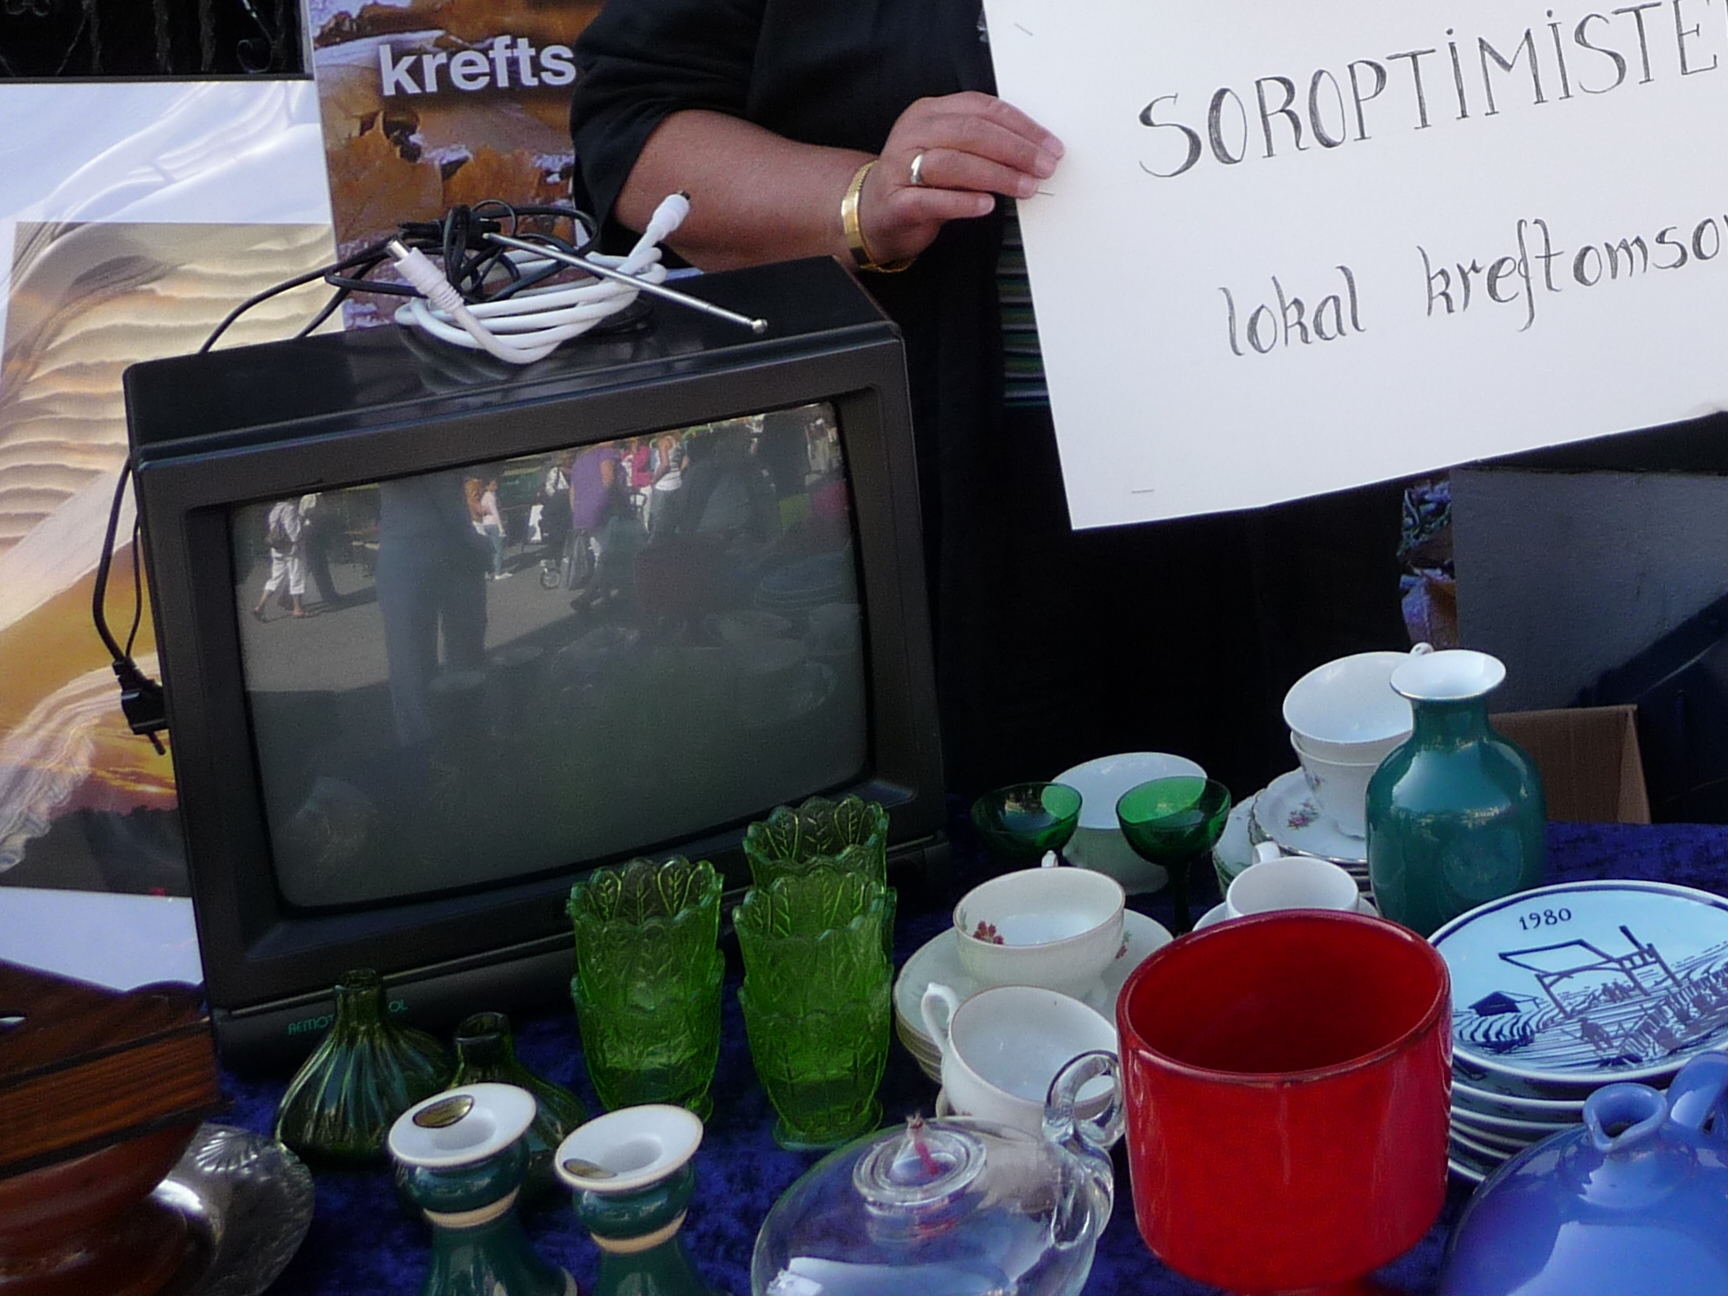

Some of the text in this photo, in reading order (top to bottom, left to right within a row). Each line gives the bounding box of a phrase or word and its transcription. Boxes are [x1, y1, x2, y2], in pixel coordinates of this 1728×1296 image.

[378, 34, 578, 97] krefts
[1218, 265, 1366, 356] lokal
[1518, 907, 1573, 932] 1980
